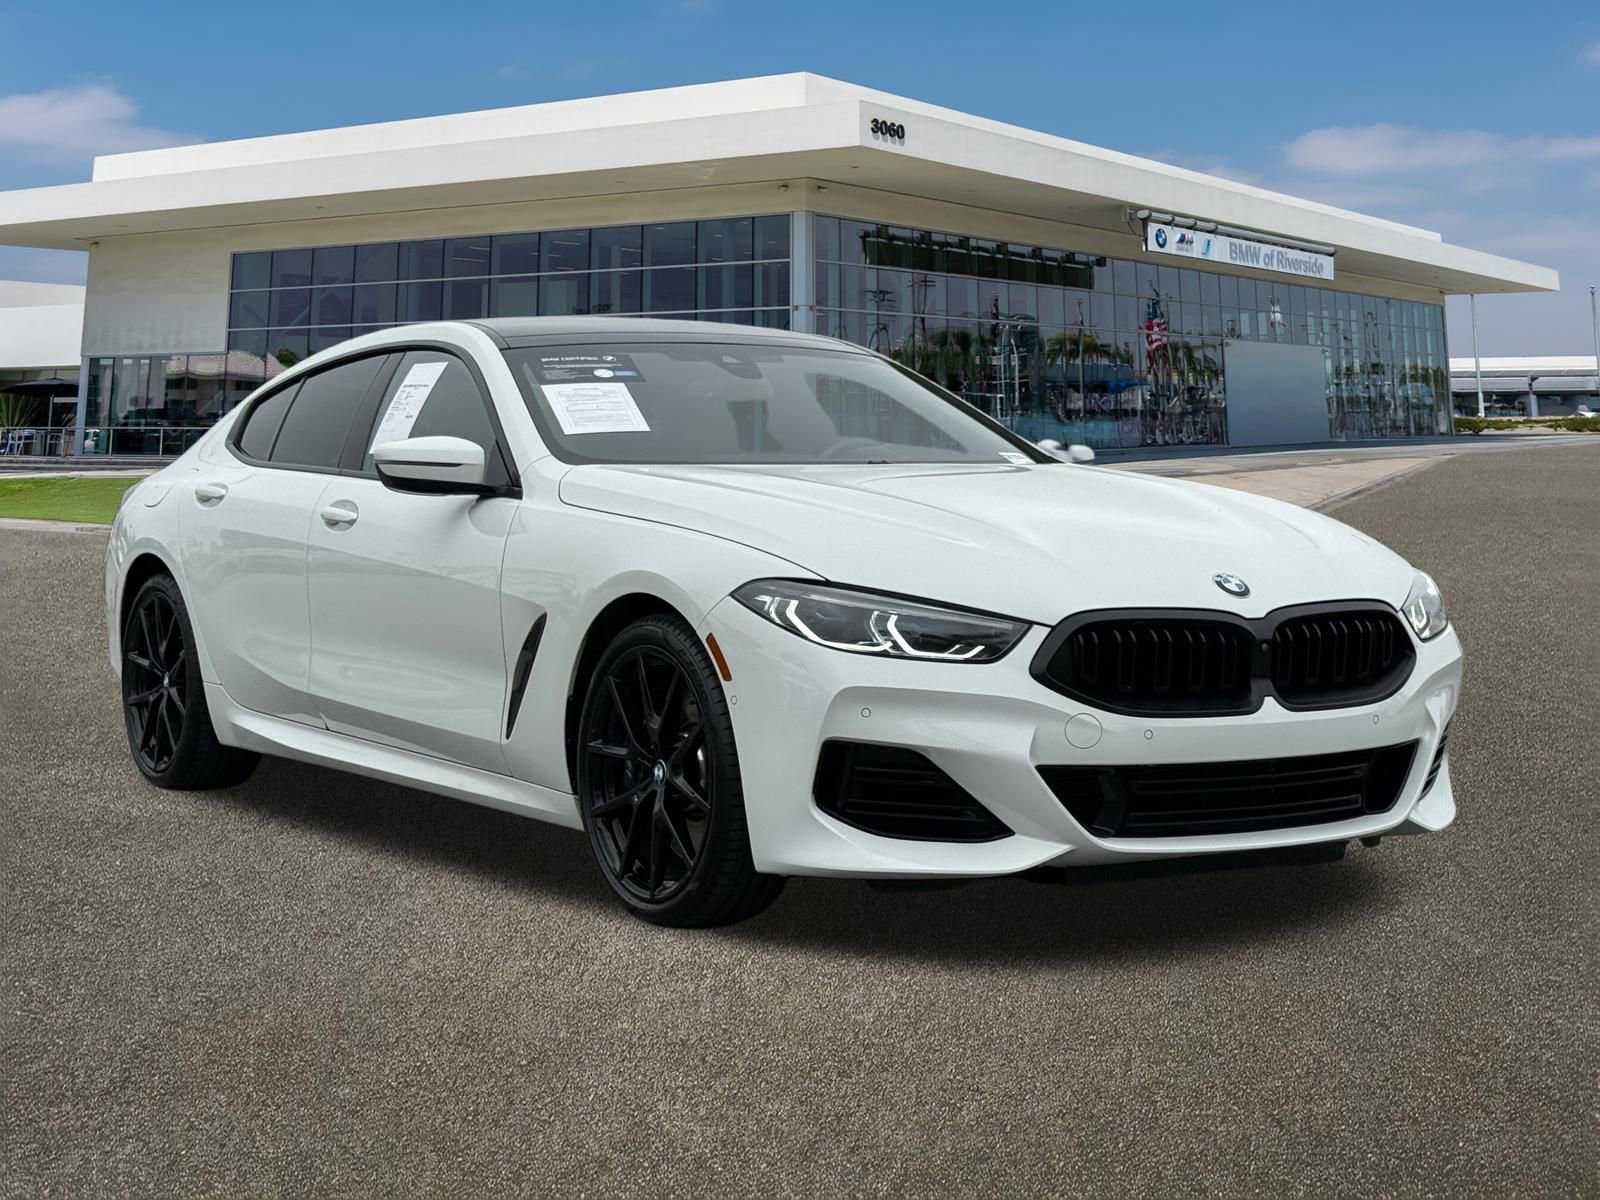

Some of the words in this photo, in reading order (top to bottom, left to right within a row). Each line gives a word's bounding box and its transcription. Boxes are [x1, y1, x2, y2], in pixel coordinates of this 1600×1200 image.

[870, 118, 905, 139] 3060
[1229, 241, 1260, 265] BMW
[1263, 249, 1275, 268] of
[1276, 251, 1325, 275] Riverside
